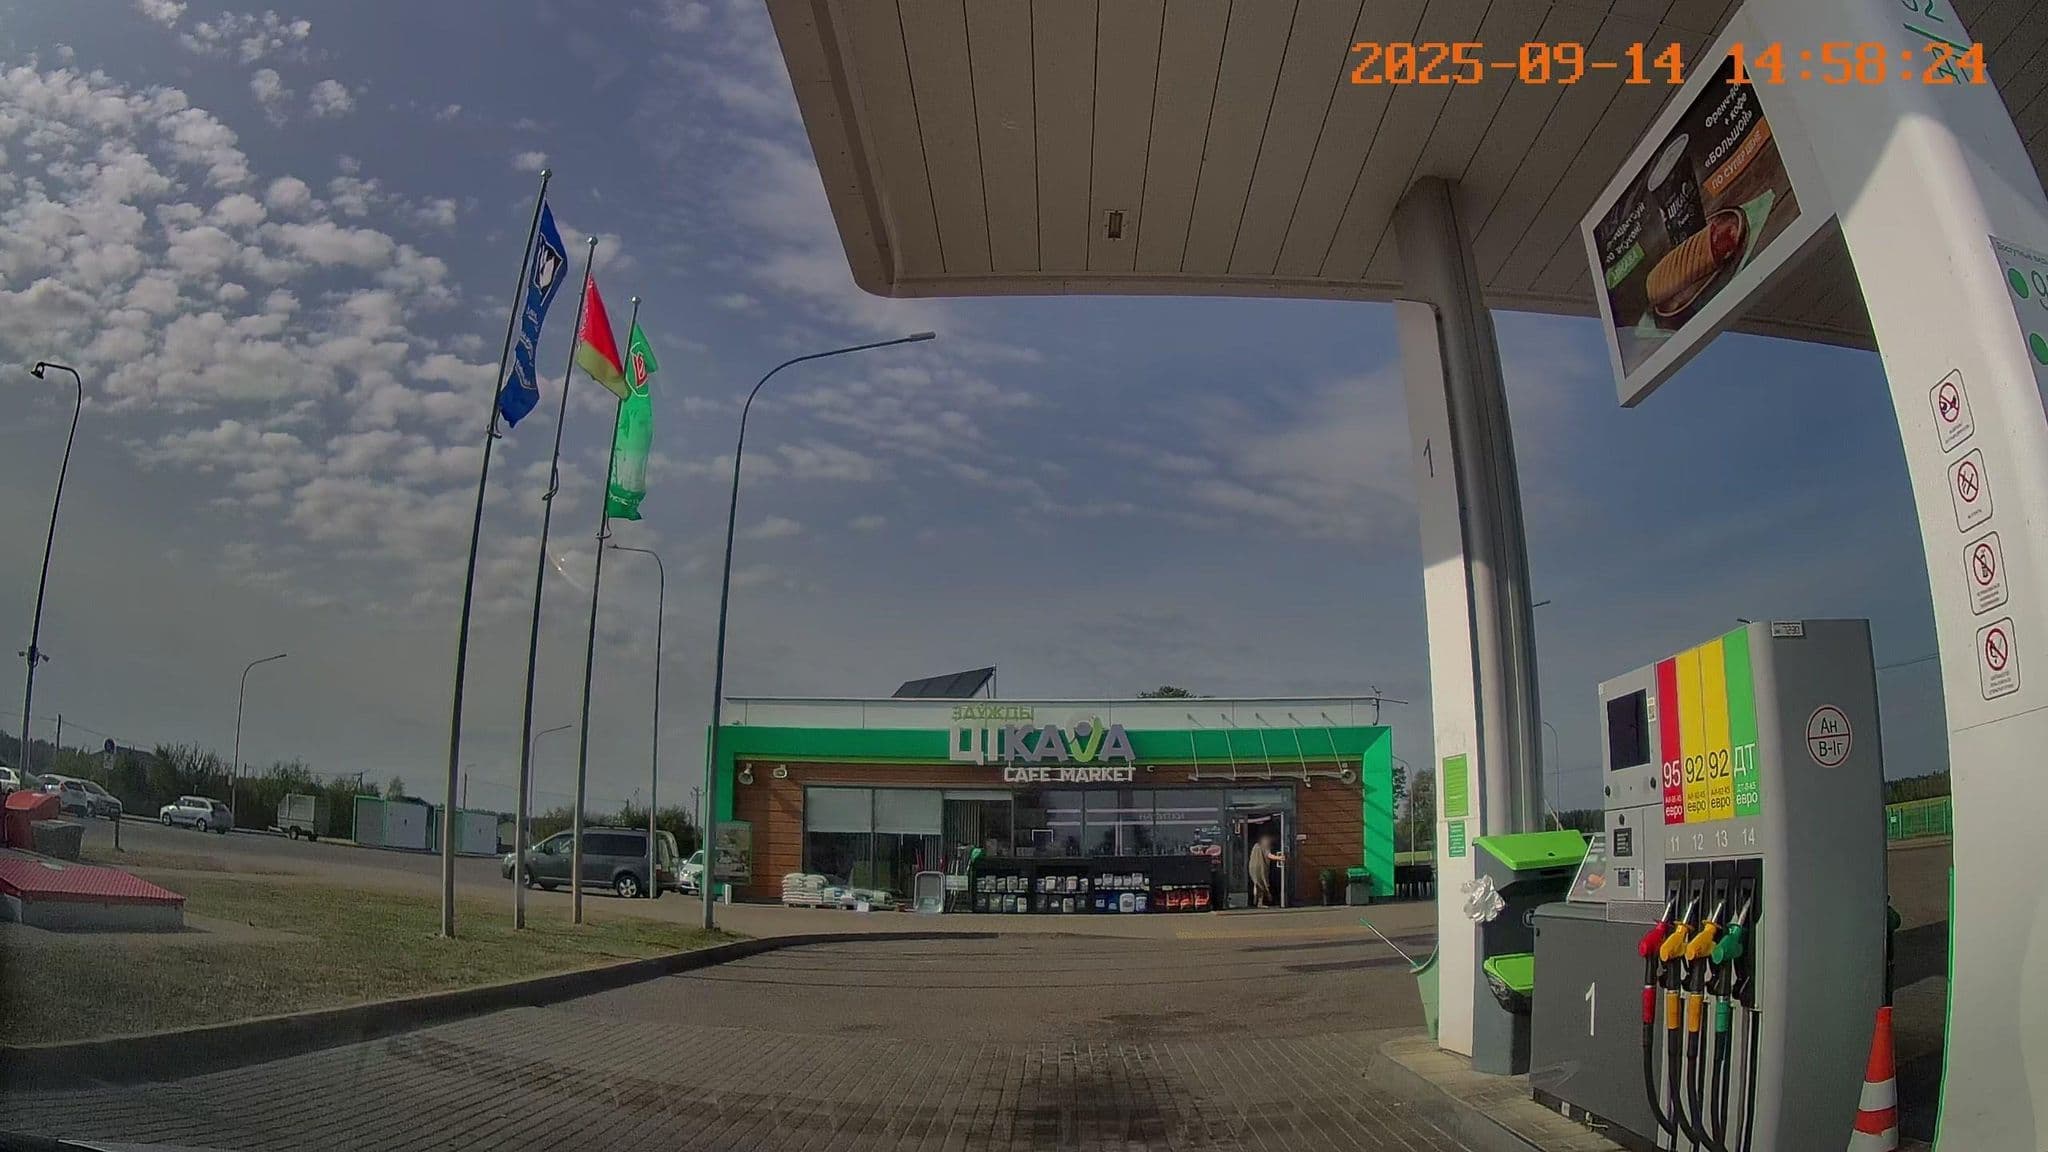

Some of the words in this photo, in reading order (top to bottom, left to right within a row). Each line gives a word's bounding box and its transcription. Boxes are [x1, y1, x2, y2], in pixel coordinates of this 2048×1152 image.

[1705, 83, 1741, 128] Френч-до
[1711, 175, 1723, 189] ПО
[1724, 151, 1745, 178] СУПЕР
[1423, 438, 1434, 478] 1
[1820, 718, 1837, 734] Ан
[1685, 755, 1704, 783] 92
[1708, 749, 1729, 779] 92
[1733, 743, 1756, 777] ДТ
[1004, 767, 1050, 782] CAFE
[1061, 767, 1136, 782] MARKET
[1663, 760, 1680, 788] 95
[1687, 800, 1706, 813] евро
[1711, 797, 1731, 810] евро
[1736, 791, 1758, 807] евро
[1665, 805, 1682, 819] евро
[1671, 836, 1680, 852] 11
[1692, 833, 1704, 851] 12
[1715, 830, 1728, 847] 13
[1742, 827, 1755, 846] 14
[1585, 982, 1595, 1036] 1
